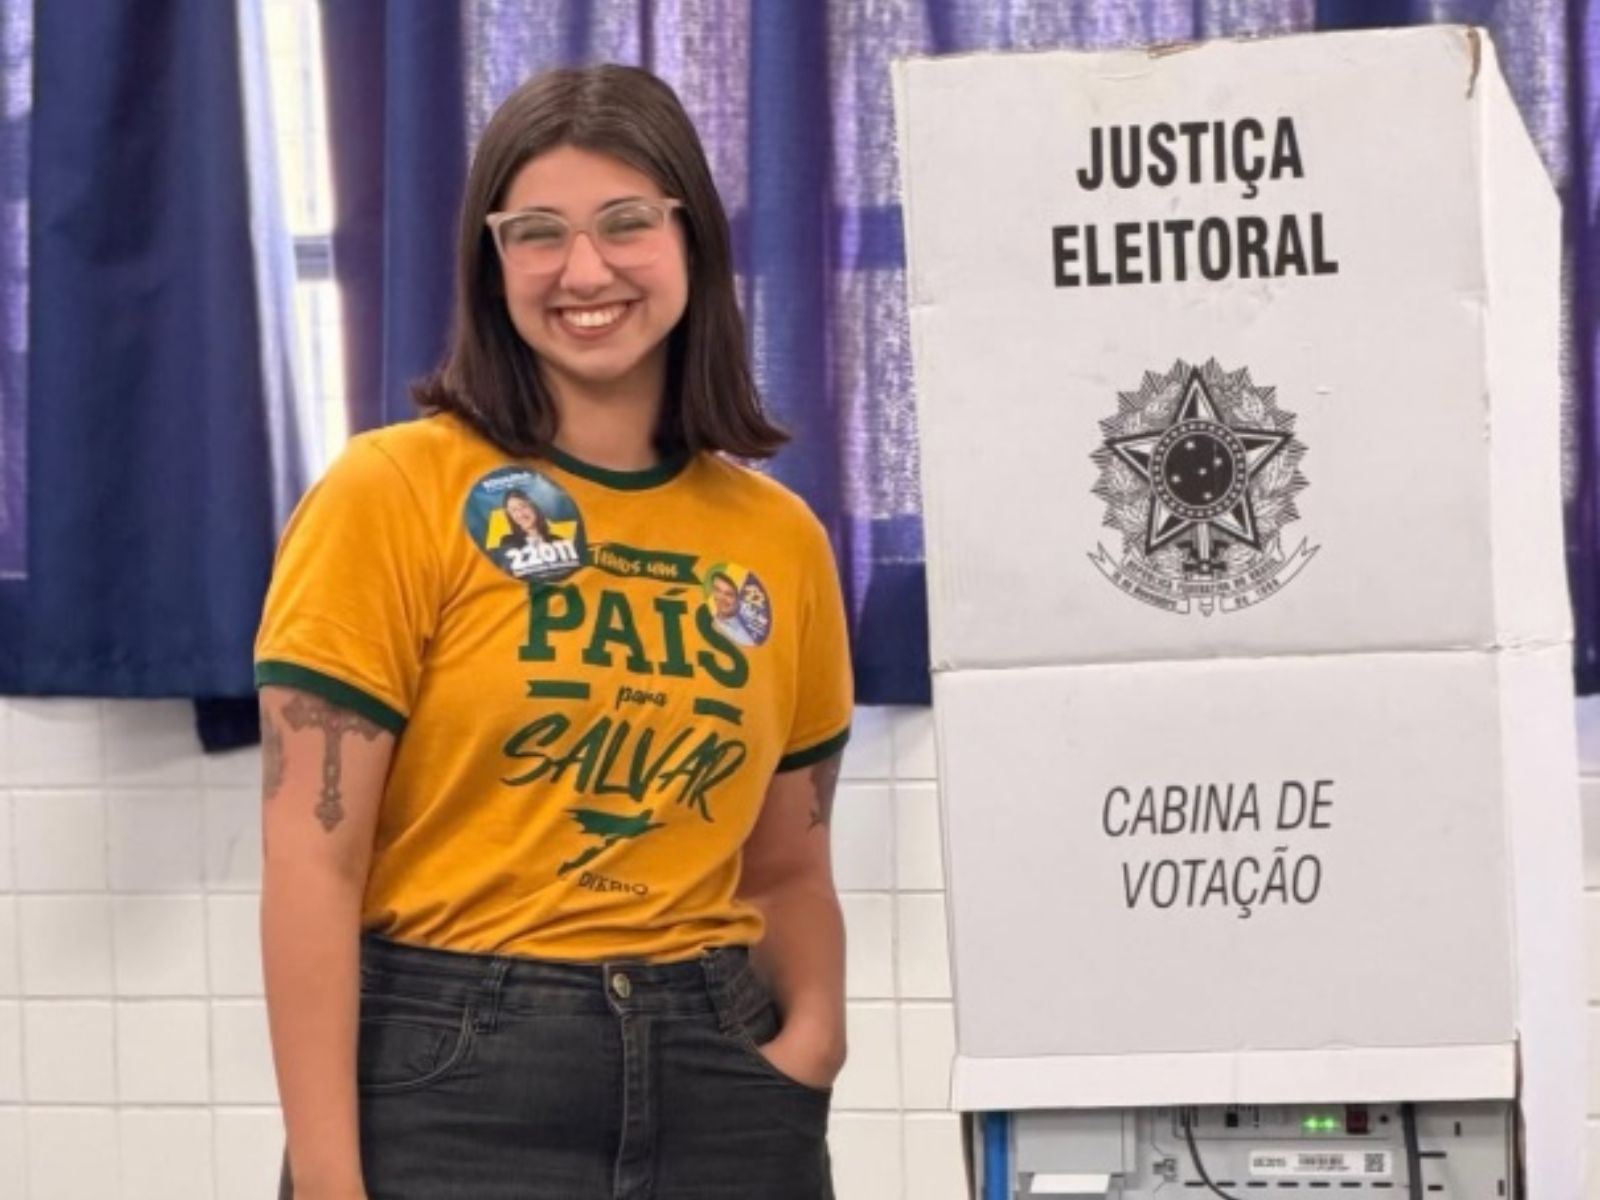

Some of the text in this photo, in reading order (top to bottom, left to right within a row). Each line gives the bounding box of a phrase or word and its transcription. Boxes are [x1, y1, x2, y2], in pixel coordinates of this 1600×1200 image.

[1076, 116, 1305, 200] JUSTIÇA
[1052, 212, 1339, 288] ELEITORAL
[517, 580, 750, 689] PAÍS
[500, 713, 747, 823] SALVAR
[1102, 780, 1334, 837] CABINA DE
[1122, 845, 1323, 919] VOTAÇÃO
